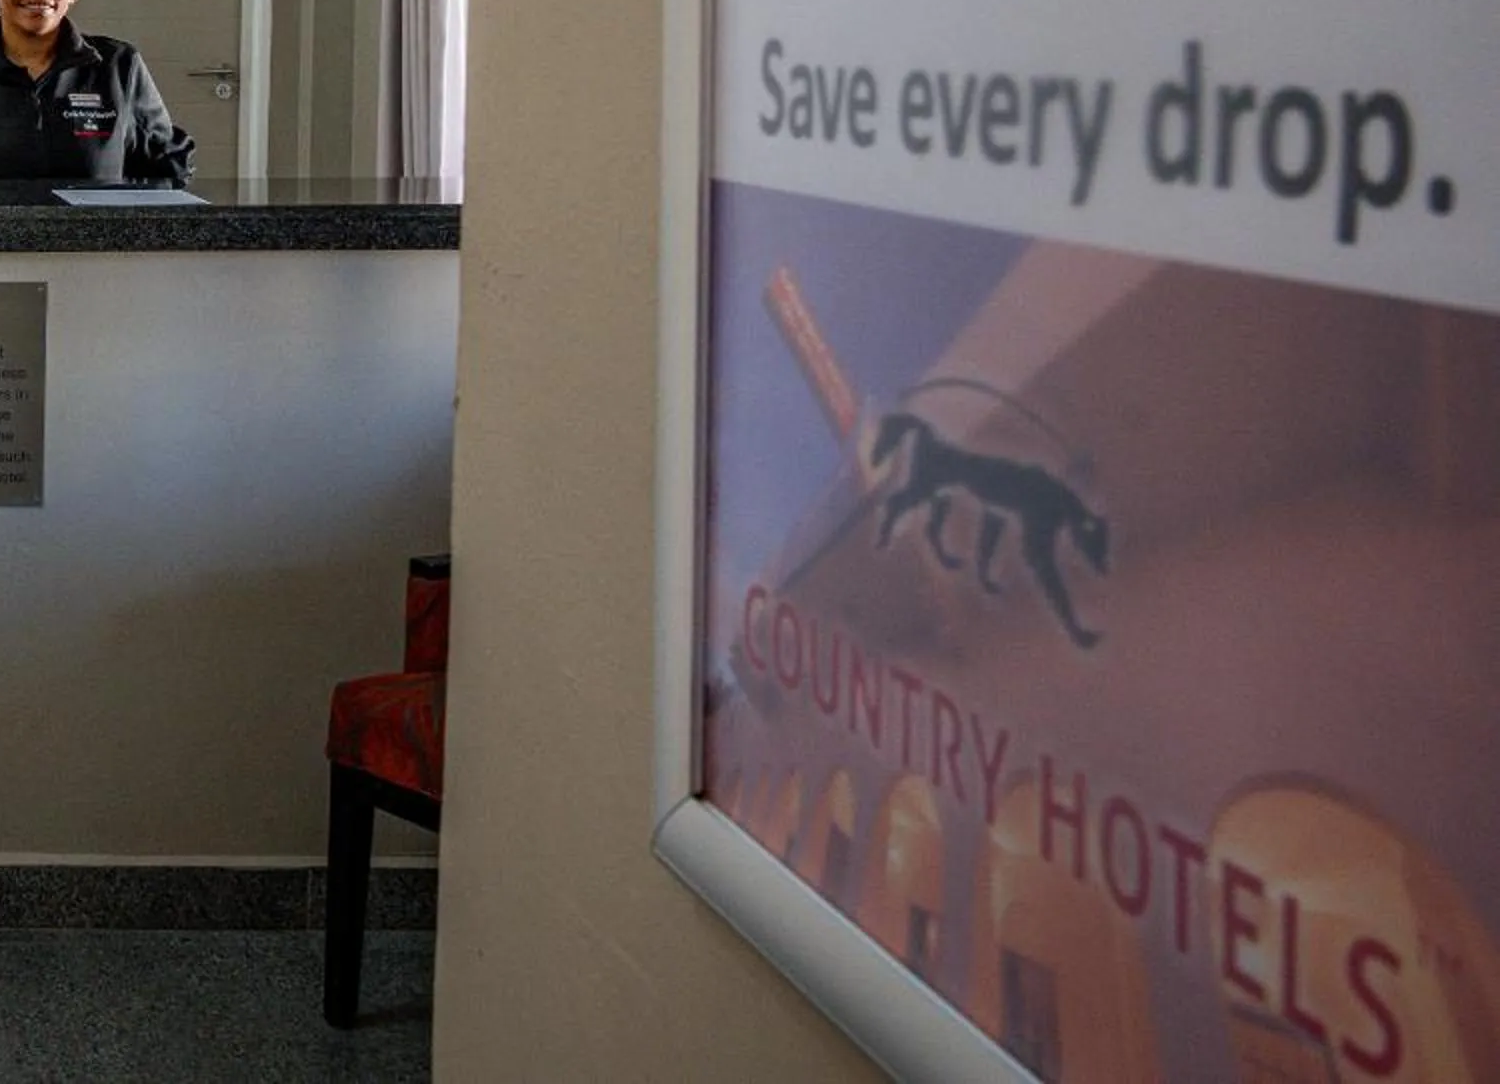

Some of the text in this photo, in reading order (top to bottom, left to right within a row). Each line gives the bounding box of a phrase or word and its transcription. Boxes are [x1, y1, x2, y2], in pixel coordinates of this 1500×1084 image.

[759, 37, 1456, 246] Save every drop.
[15, 388, 29, 401] in
[743, 584, 1404, 1078] COUNTRY HOTELS
